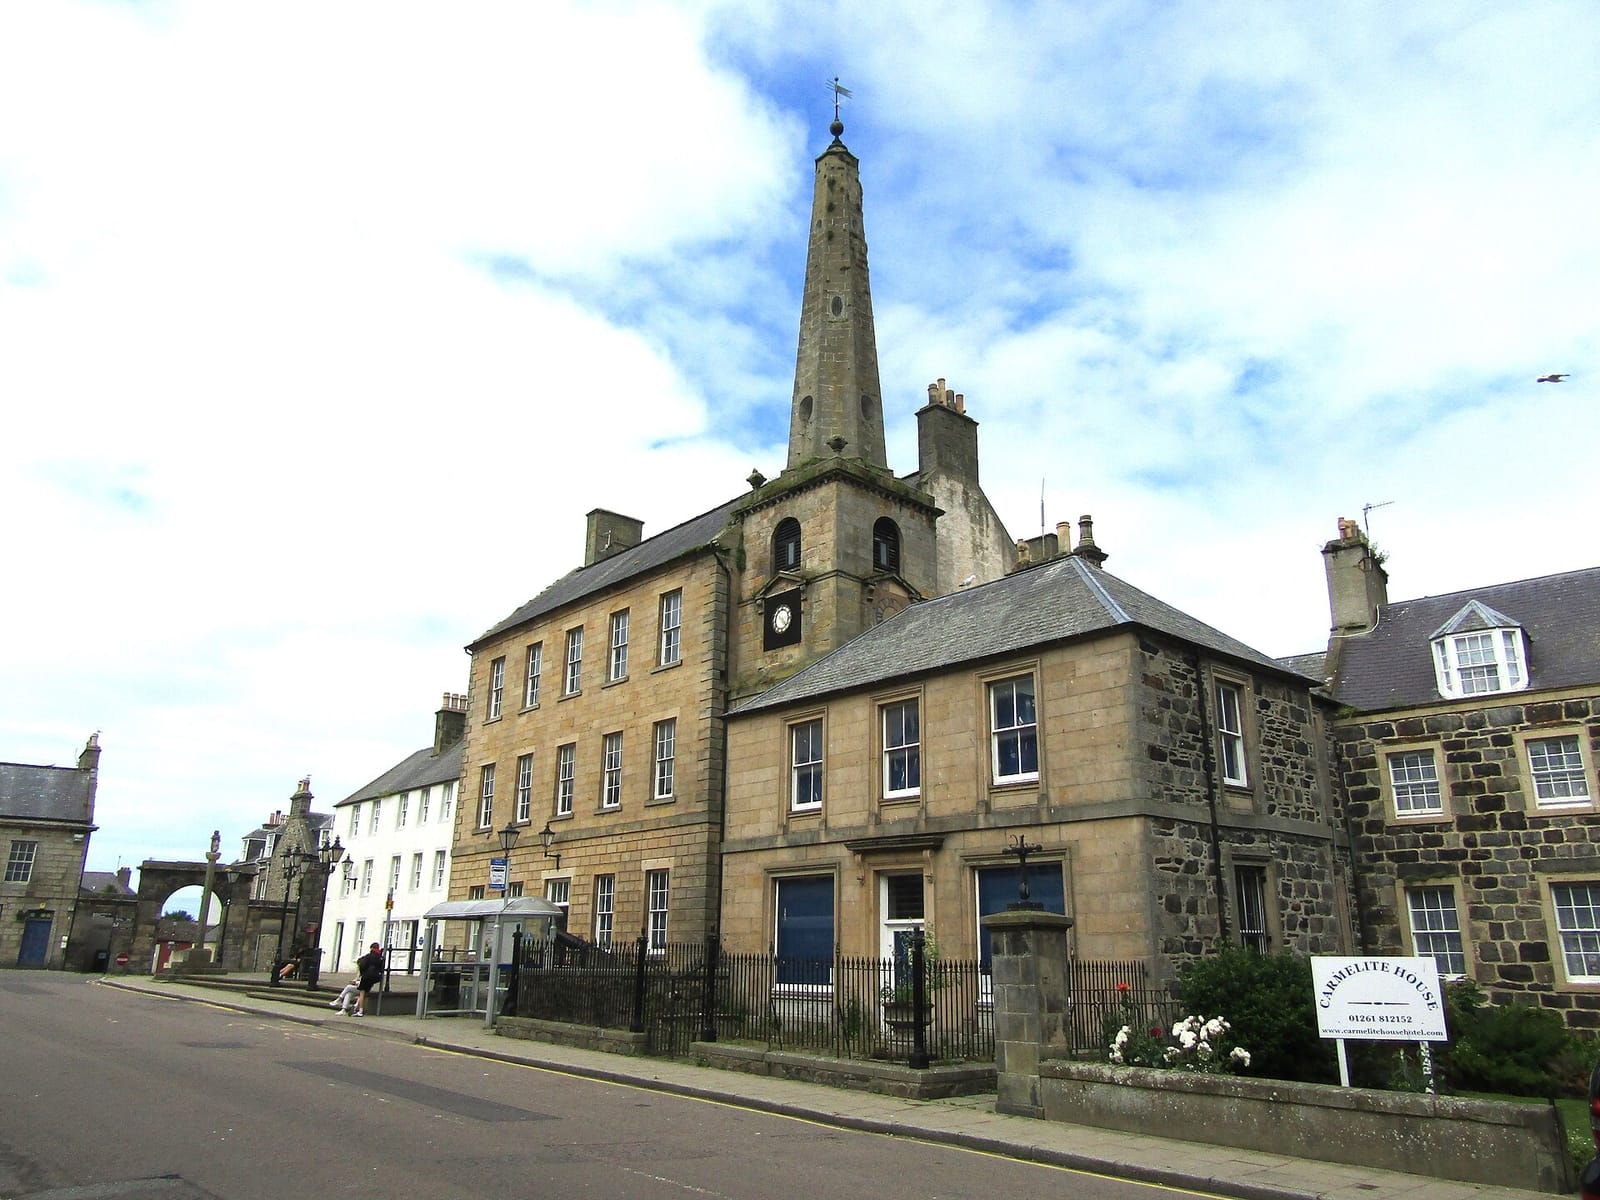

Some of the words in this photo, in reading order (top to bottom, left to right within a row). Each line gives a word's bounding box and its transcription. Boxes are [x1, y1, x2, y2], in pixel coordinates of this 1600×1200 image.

[1320, 961, 1390, 1009] CARMELITE
[1393, 966, 1439, 1011] HOUSE
[1379, 1015, 1412, 1023] 812152
[1322, 1027, 1443, 1036] www.carmelitehousehotel.com
